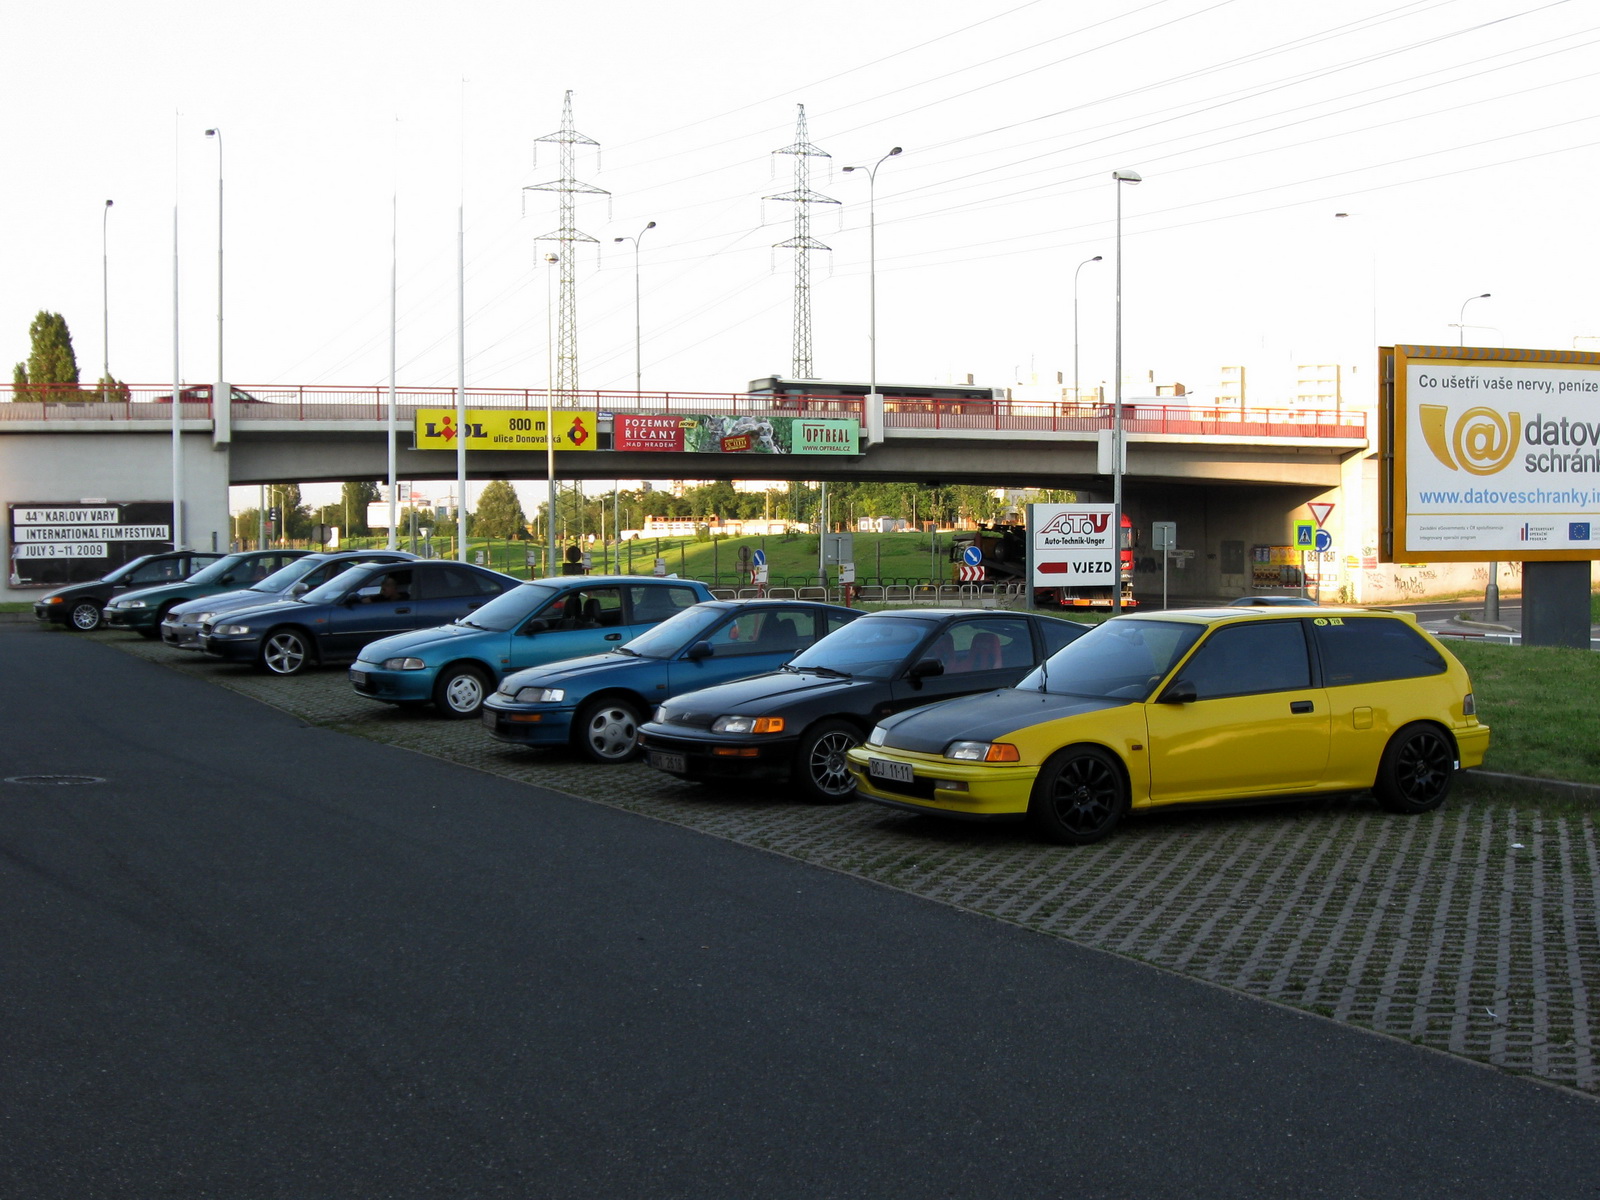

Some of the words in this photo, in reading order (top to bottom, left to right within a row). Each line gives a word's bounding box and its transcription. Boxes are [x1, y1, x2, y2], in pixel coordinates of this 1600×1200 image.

[1418, 374, 1438, 388] Co
[1442, 375, 1479, 389] ušetří
[1483, 376, 1513, 390] vaše
[1517, 379, 1555, 394] nervy,
[1558, 378, 1599, 394] peníze
[509, 418, 532, 431] 800
[535, 420, 546, 431] m
[625, 418, 676, 428] POZEMKY
[493, 434, 514, 443] ulice
[516, 434, 562, 443] Donovalká
[625, 427, 676, 439] ŘÍČANY
[806, 428, 850, 443] OPTREAL
[1419, 487, 1600, 507] www.datoveschranky.i
[45, 510, 88, 521] KARLOVY
[90, 510, 115, 521] VARY
[26, 528, 99, 540] INTERNATIONAL
[101, 527, 123, 539] FILM
[124, 526, 167, 538] FESTIVAL
[25, 545, 47, 556] JULY
[48, 545, 55, 556] 3
[77, 545, 103, 556] 2009
[1072, 561, 1113, 574] VJEZD
